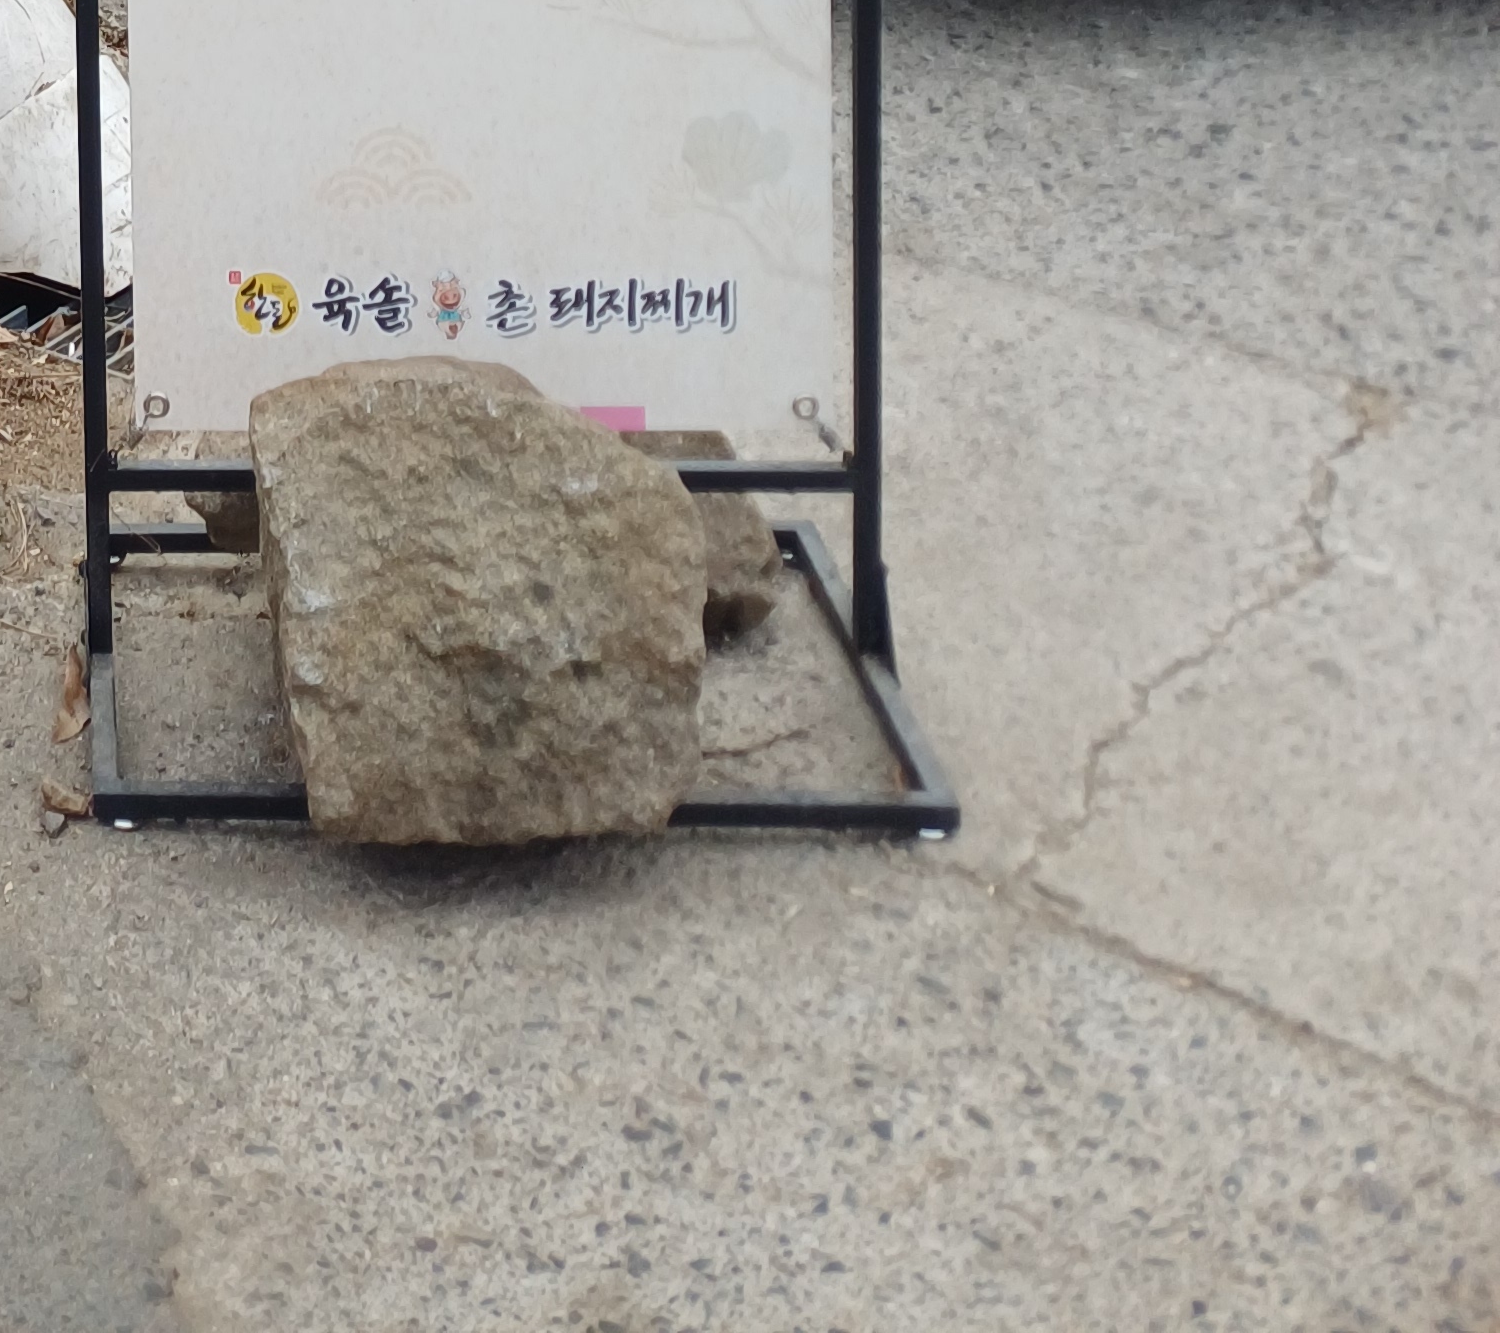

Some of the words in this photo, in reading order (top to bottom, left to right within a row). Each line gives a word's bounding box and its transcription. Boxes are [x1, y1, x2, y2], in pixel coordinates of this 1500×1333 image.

[312, 274, 414, 333] 육솔
[486, 278, 533, 334] 촌
[549, 277, 733, 331] 돼지찌개
